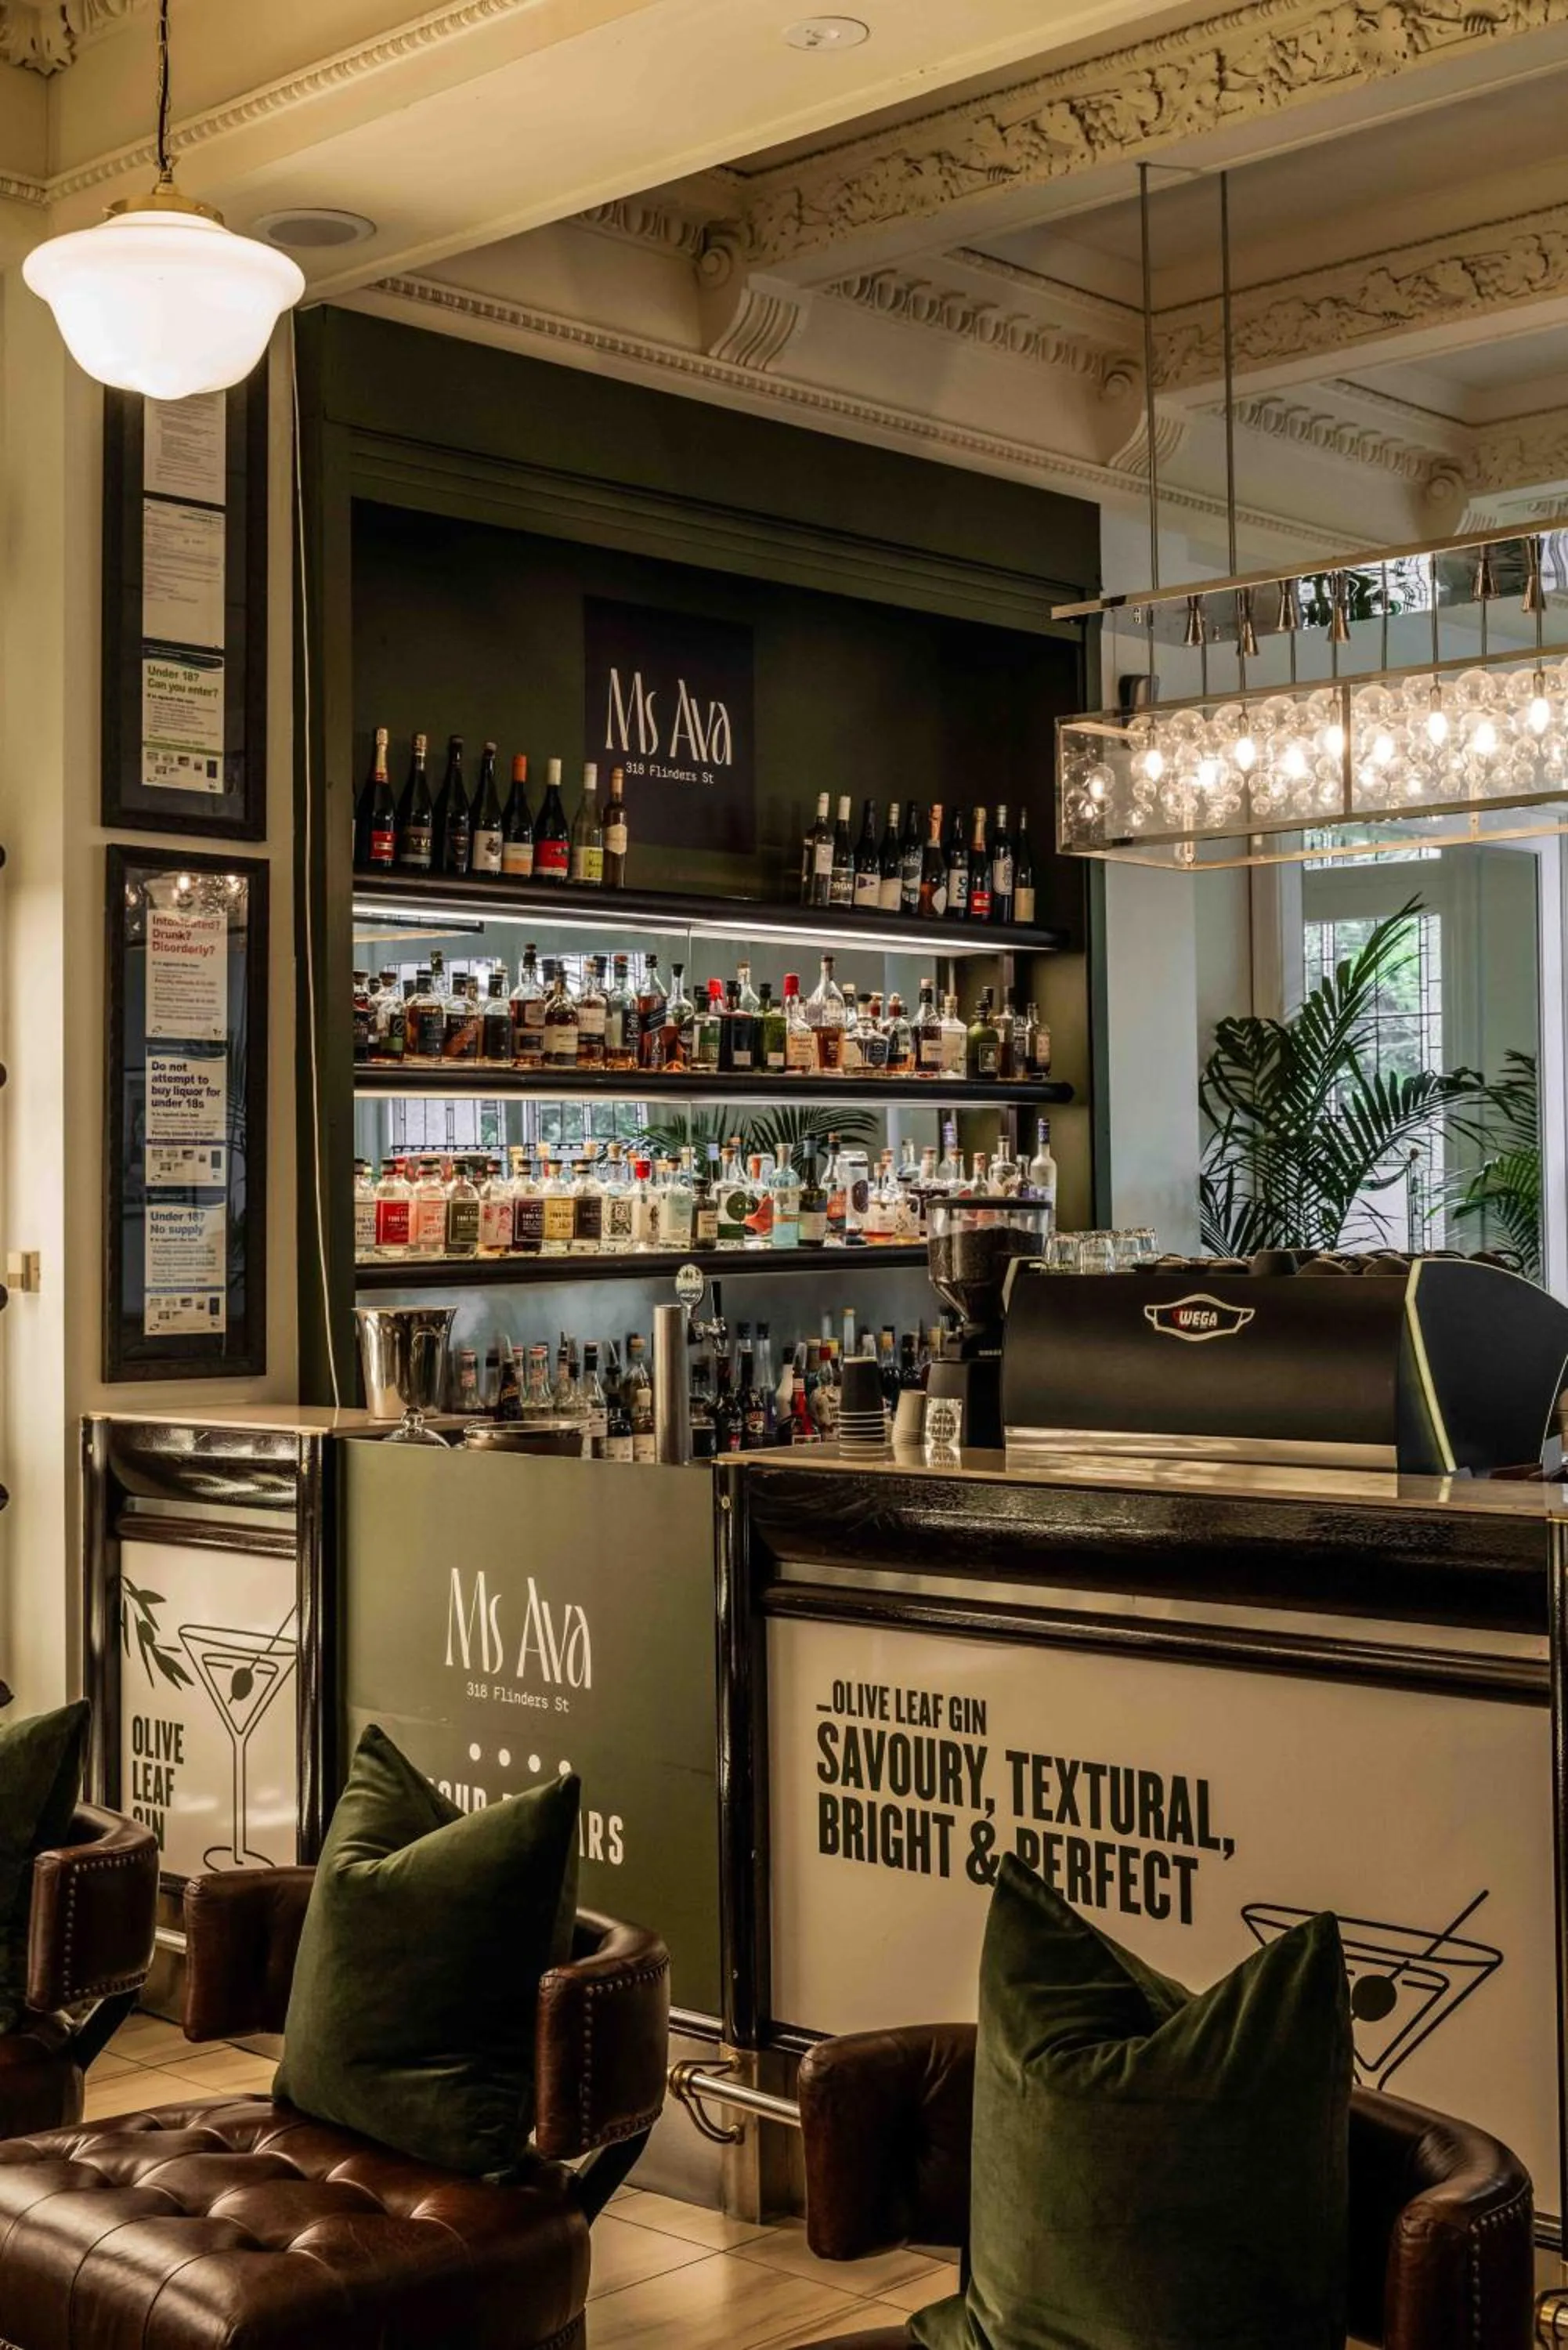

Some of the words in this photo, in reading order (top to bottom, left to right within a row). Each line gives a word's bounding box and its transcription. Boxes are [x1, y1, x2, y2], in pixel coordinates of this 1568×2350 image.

[147, 665, 179, 680] Under
[182, 671, 200, 683] 18?
[147, 678, 167, 690] Can
[168, 682, 186, 694] you
[188, 685, 219, 698] enter?
[605, 667, 659, 756] Ms
[670, 678, 732, 766] Ava
[626, 762, 645, 776] 318
[649, 765, 697, 783] Flinders
[702, 772, 714, 784] St
[152, 929, 192, 941] Drunk?
[152, 942, 215, 957] Disorderly?
[151, 1061, 167, 1071] Do
[169, 1062, 188, 1072] not
[151, 1074, 194, 1086] attempt
[198, 1076, 209, 1085] to
[151, 1086, 171, 1097] buy
[173, 1086, 204, 1097] liquor
[206, 1086, 221, 1097] for
[151, 1098, 182, 1108] under
[186, 1098, 204, 1108] 18s
[150, 1211, 184, 1222] Under
[150, 1224, 165, 1234] No
[169, 1225, 204, 1236] supply
[1179, 1310, 1218, 1327] WEGA
[445, 1567, 504, 1675] Ms
[517, 1577, 592, 1690] Ava
[466, 1681, 489, 1699] 318
[493, 1686, 549, 1709] Flinders
[555, 1696, 570, 1713] St
[895, 1688, 944, 1728] LEAF
[948, 1696, 988, 1736] GIN
[132, 1714, 184, 1764] OLIVE
[132, 1760, 175, 1807] LEAF
[816, 1721, 996, 1820] SAVOURY,
[1005, 1749, 1236, 1861] TEXTURAL,
[818, 1791, 956, 1878] BRIGHT
[966, 1819, 1000, 1885] &
[1016, 1827, 1199, 1925] PERFECT
